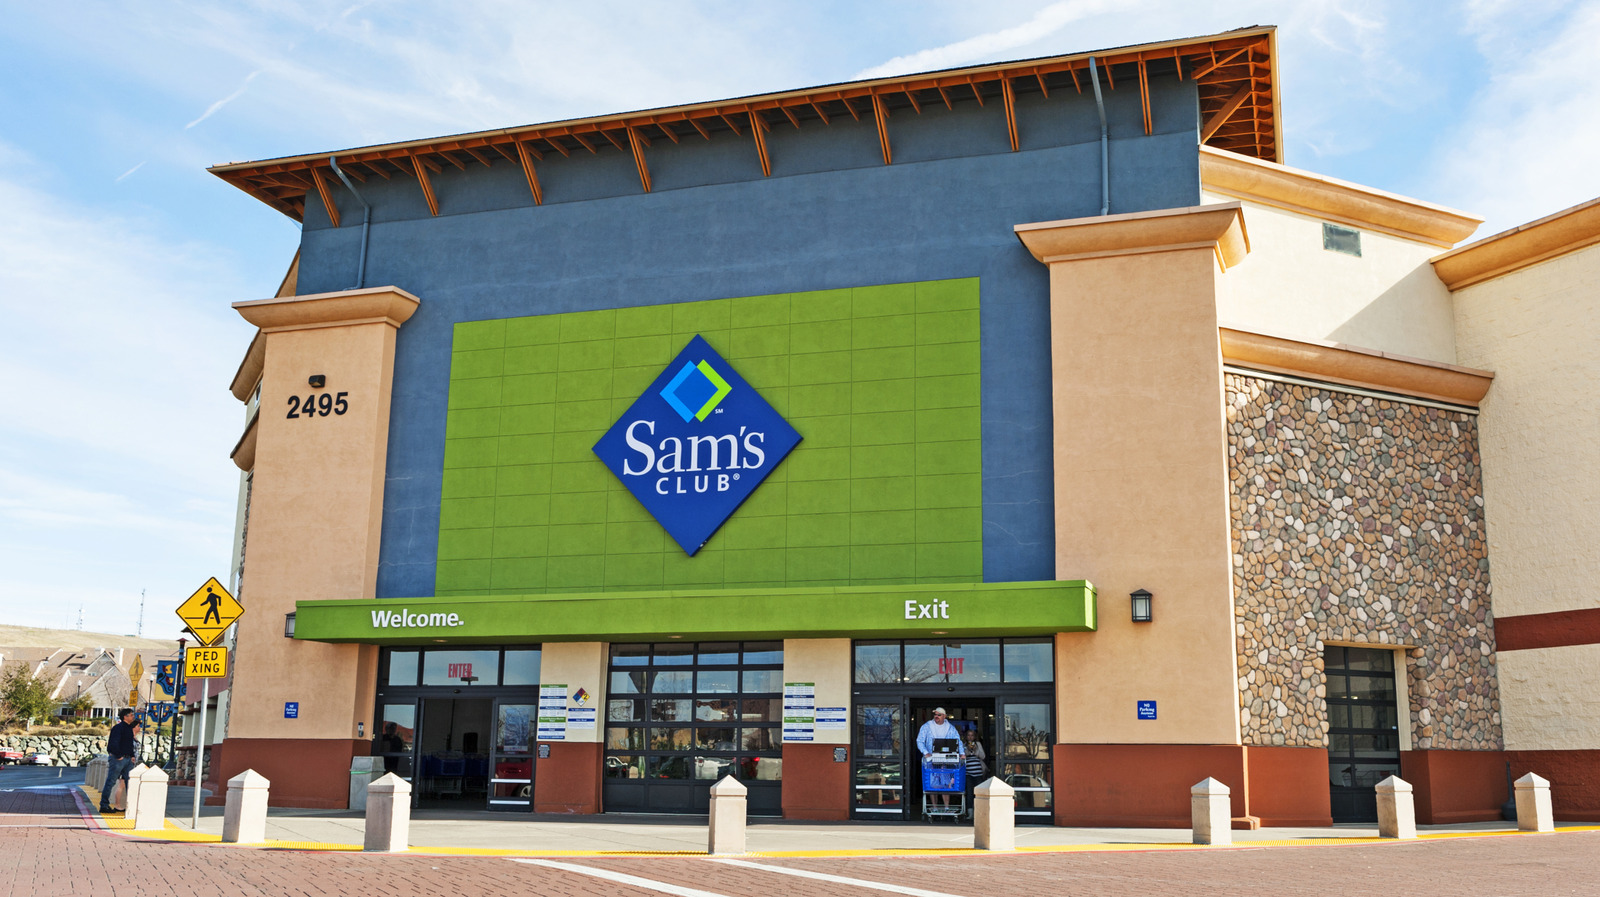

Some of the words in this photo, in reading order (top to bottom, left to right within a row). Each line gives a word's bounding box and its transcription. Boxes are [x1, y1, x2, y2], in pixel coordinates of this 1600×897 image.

[286, 392, 349, 419] 2495
[623, 420, 765, 476] Sam's
[371, 608, 465, 629] Welcome.
[904, 598, 950, 620] Exit
[194, 651, 218, 661] PED
[191, 663, 220, 674] XING
[448, 663, 473, 678] ENTER
[938, 657, 965, 675] EXIT
